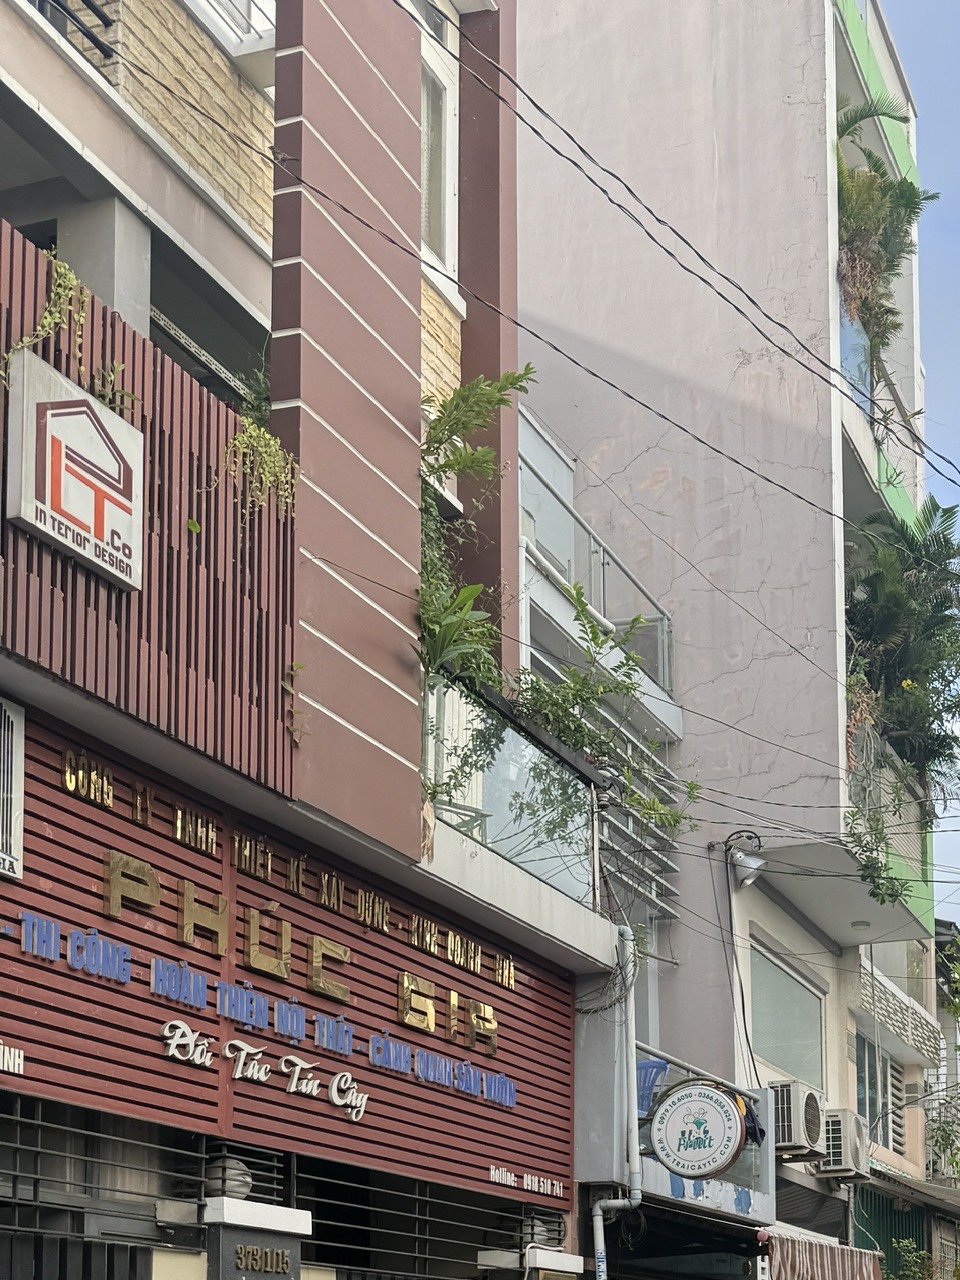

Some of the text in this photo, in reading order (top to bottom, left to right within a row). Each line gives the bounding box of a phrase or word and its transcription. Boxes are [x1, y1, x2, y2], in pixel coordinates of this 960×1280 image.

[62, 746, 113, 809] CÔNG
[317, 870, 344, 911] XÂY
[356, 888, 391, 934] DỰNG
[409, 913, 438, 955] KINH
[446, 929, 482, 974] DOANH
[495, 953, 516, 990] NHÀ
[104, 848, 351, 1004] PHÚC
[19, 911, 517, 1108] THI CÔNG HOÀN THIỆN NỘI THẤT CẢNH QUAN SÂN VƯỜN
[160, 1020, 215, 1067] Đối
[222, 1039, 272, 1083] Tác
[328, 1071, 370, 1122] Cậy
